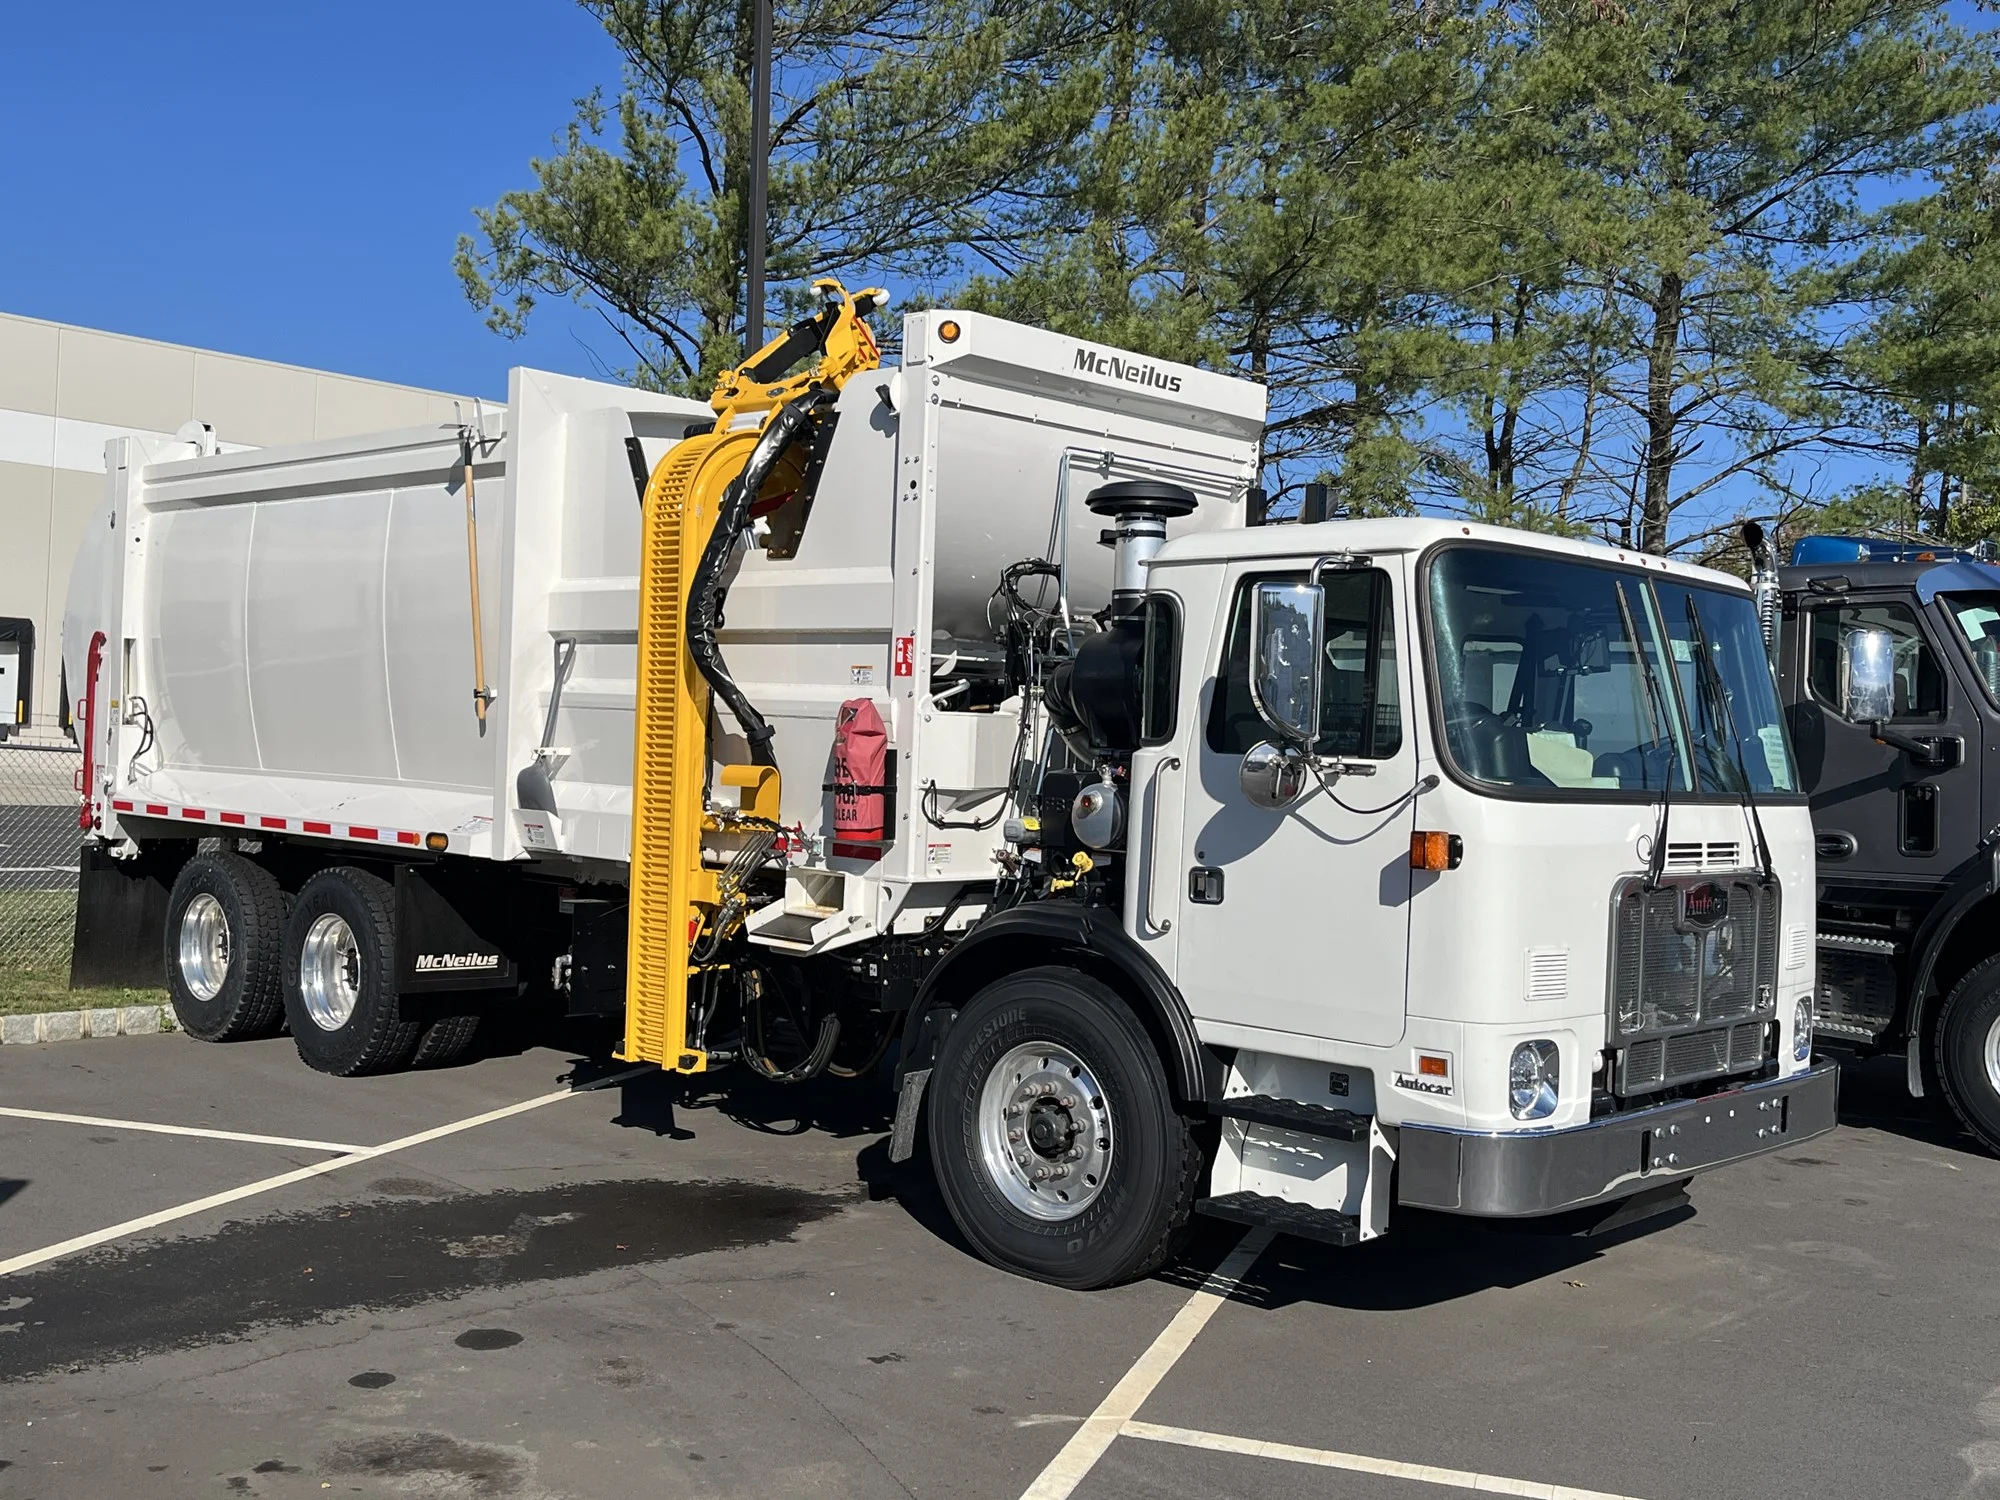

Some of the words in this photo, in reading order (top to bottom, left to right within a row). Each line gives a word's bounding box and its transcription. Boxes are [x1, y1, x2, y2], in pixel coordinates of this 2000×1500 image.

[1074, 348, 1182, 392] McNeilus
[1686, 894, 1728, 916] Autocar
[415, 952, 499, 969] McNeilus
[1395, 1073, 1453, 1096] Autocar
